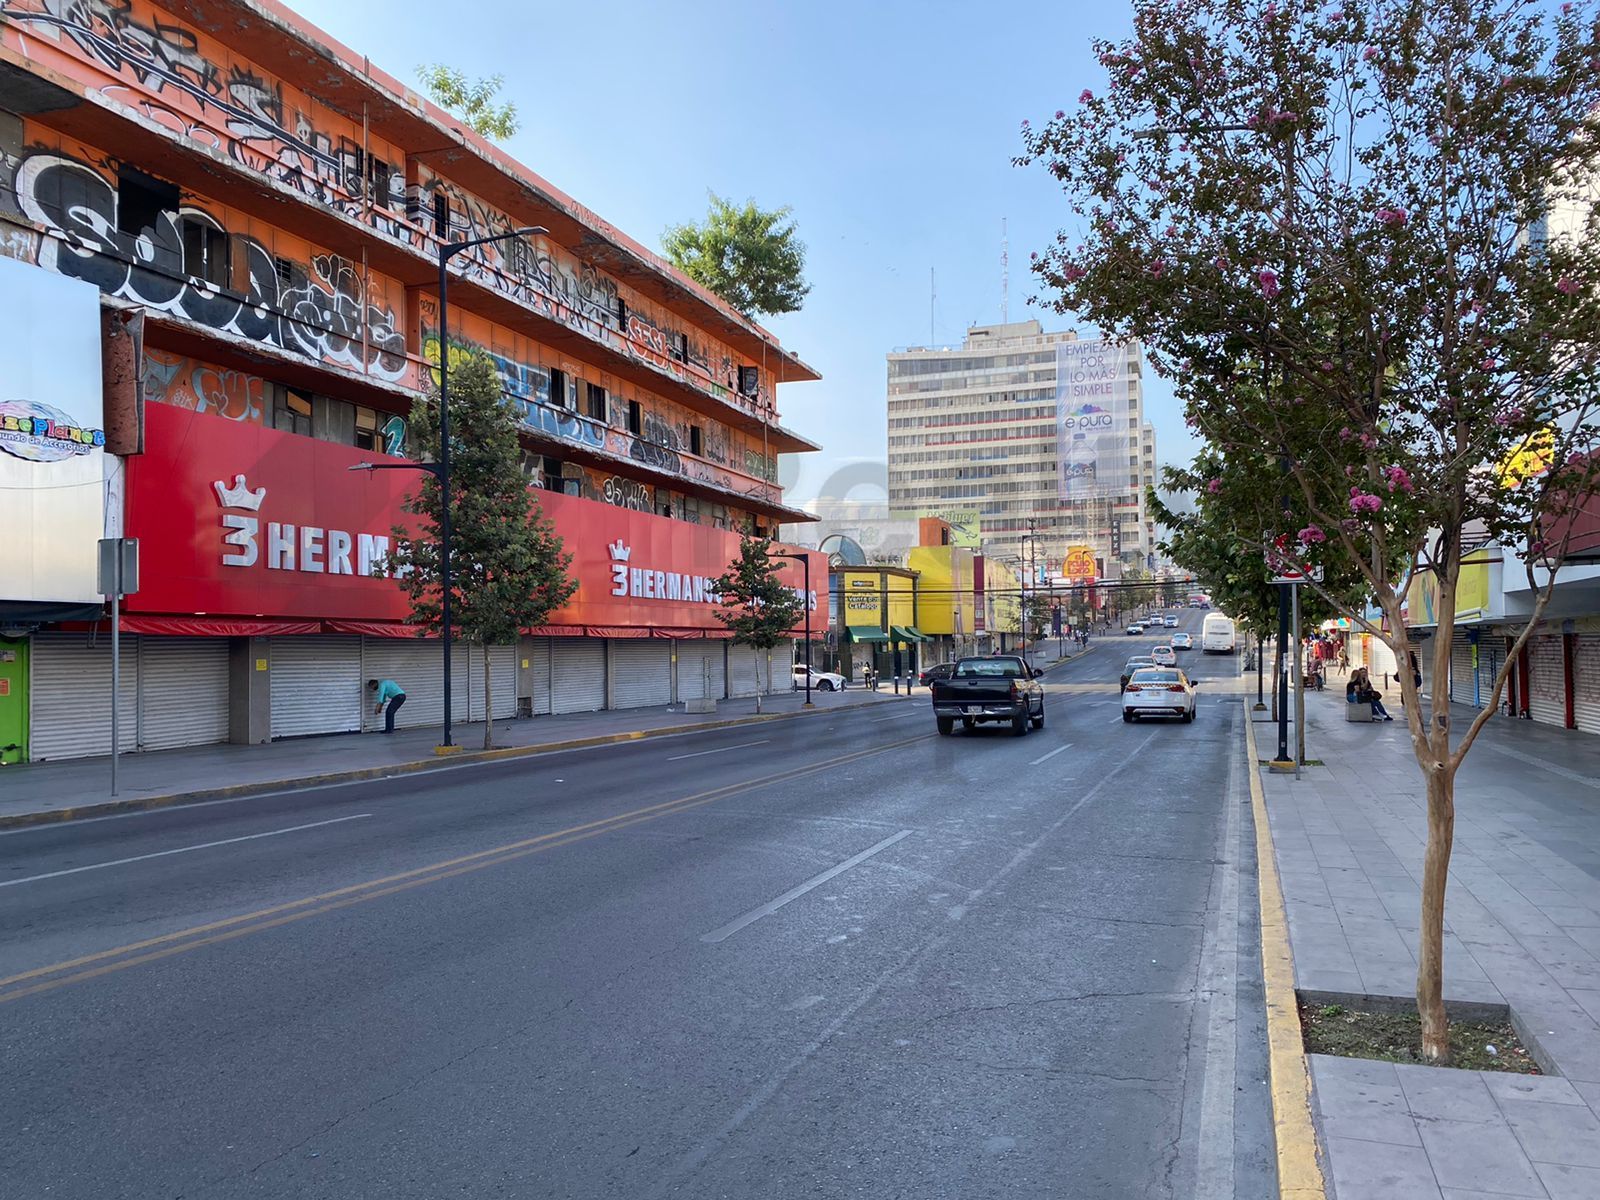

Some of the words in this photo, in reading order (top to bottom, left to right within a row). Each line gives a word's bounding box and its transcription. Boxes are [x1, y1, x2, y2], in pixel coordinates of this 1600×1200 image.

[1066, 341, 1116, 356] EMPIEZA
[1081, 356, 1105, 368] POR
[1070, 371, 1085, 384] LO
[1074, 382, 1113, 397] SIMPLE
